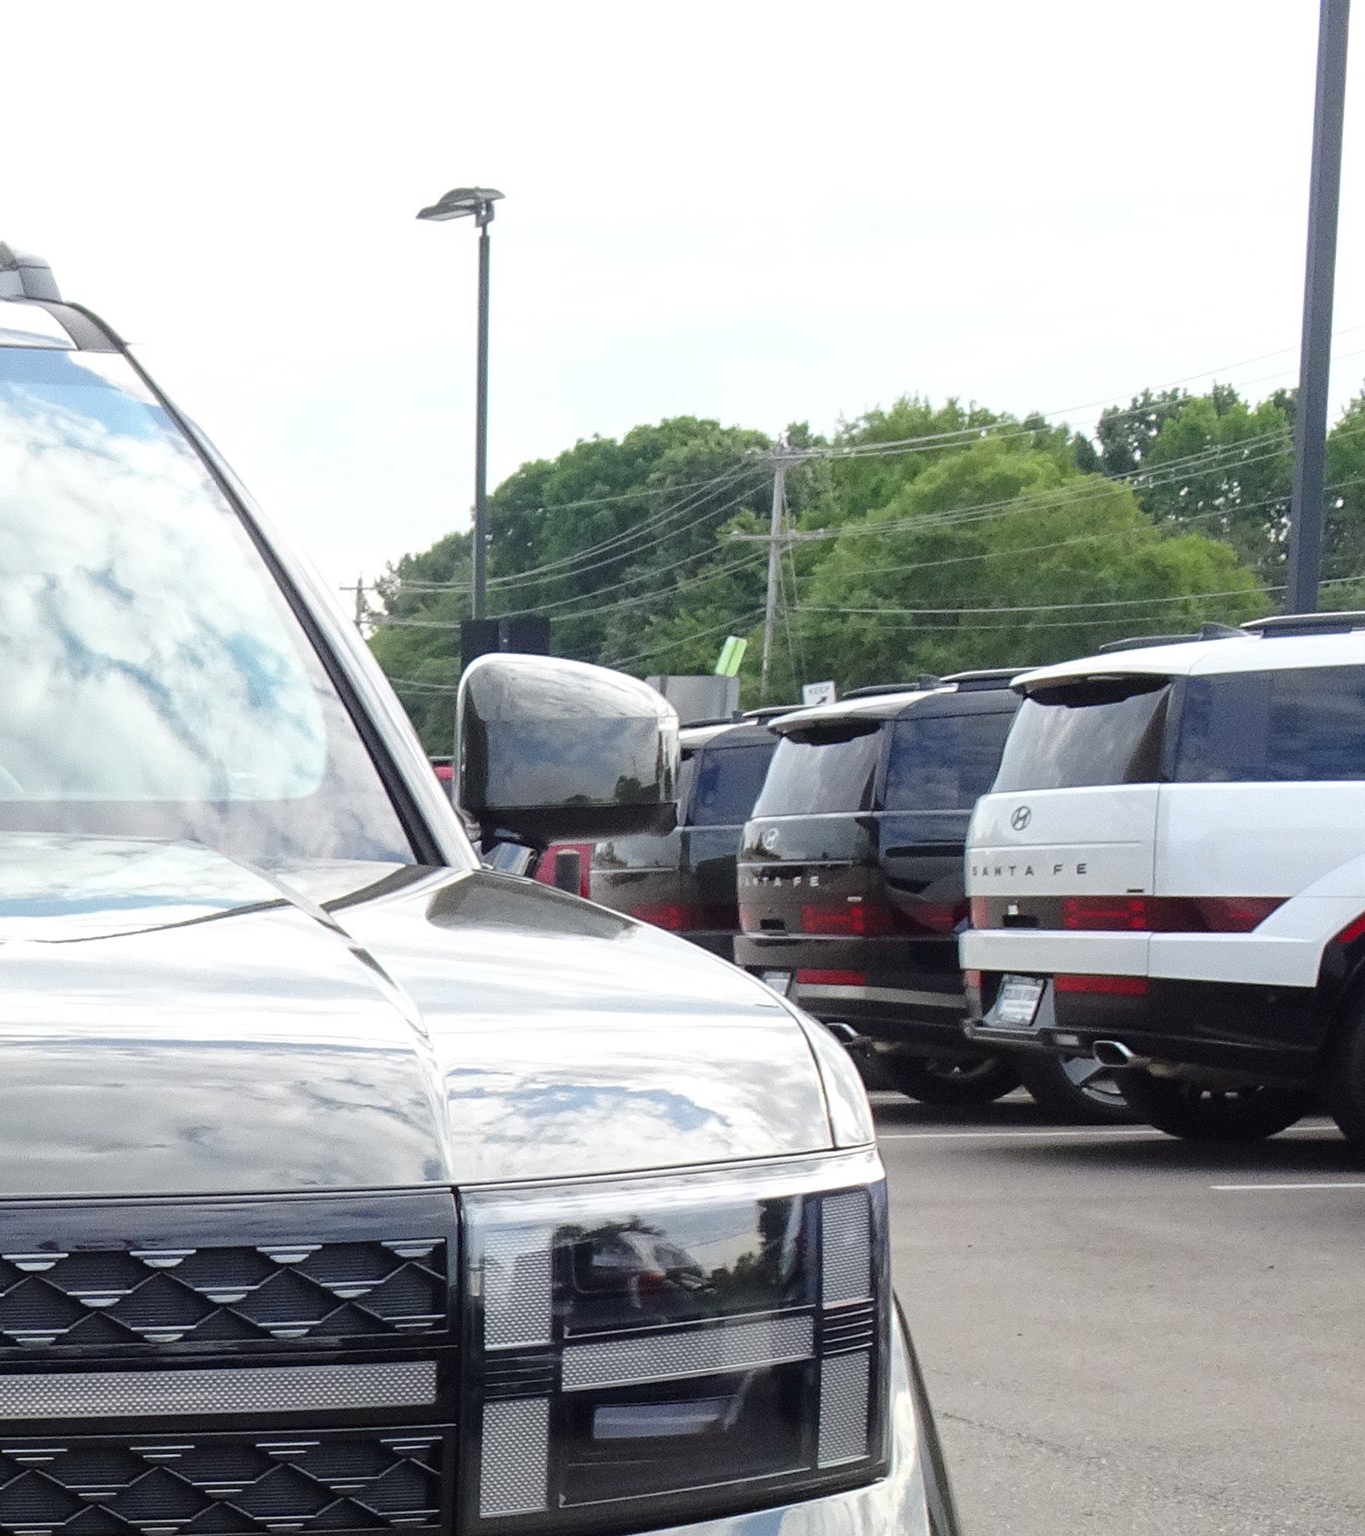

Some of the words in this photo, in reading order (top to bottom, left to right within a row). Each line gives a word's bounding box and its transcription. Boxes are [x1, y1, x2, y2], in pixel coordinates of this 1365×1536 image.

[971, 864, 1035, 877] SANTA
[1052, 863, 1088, 876] FE
[793, 875, 820, 888] FE
